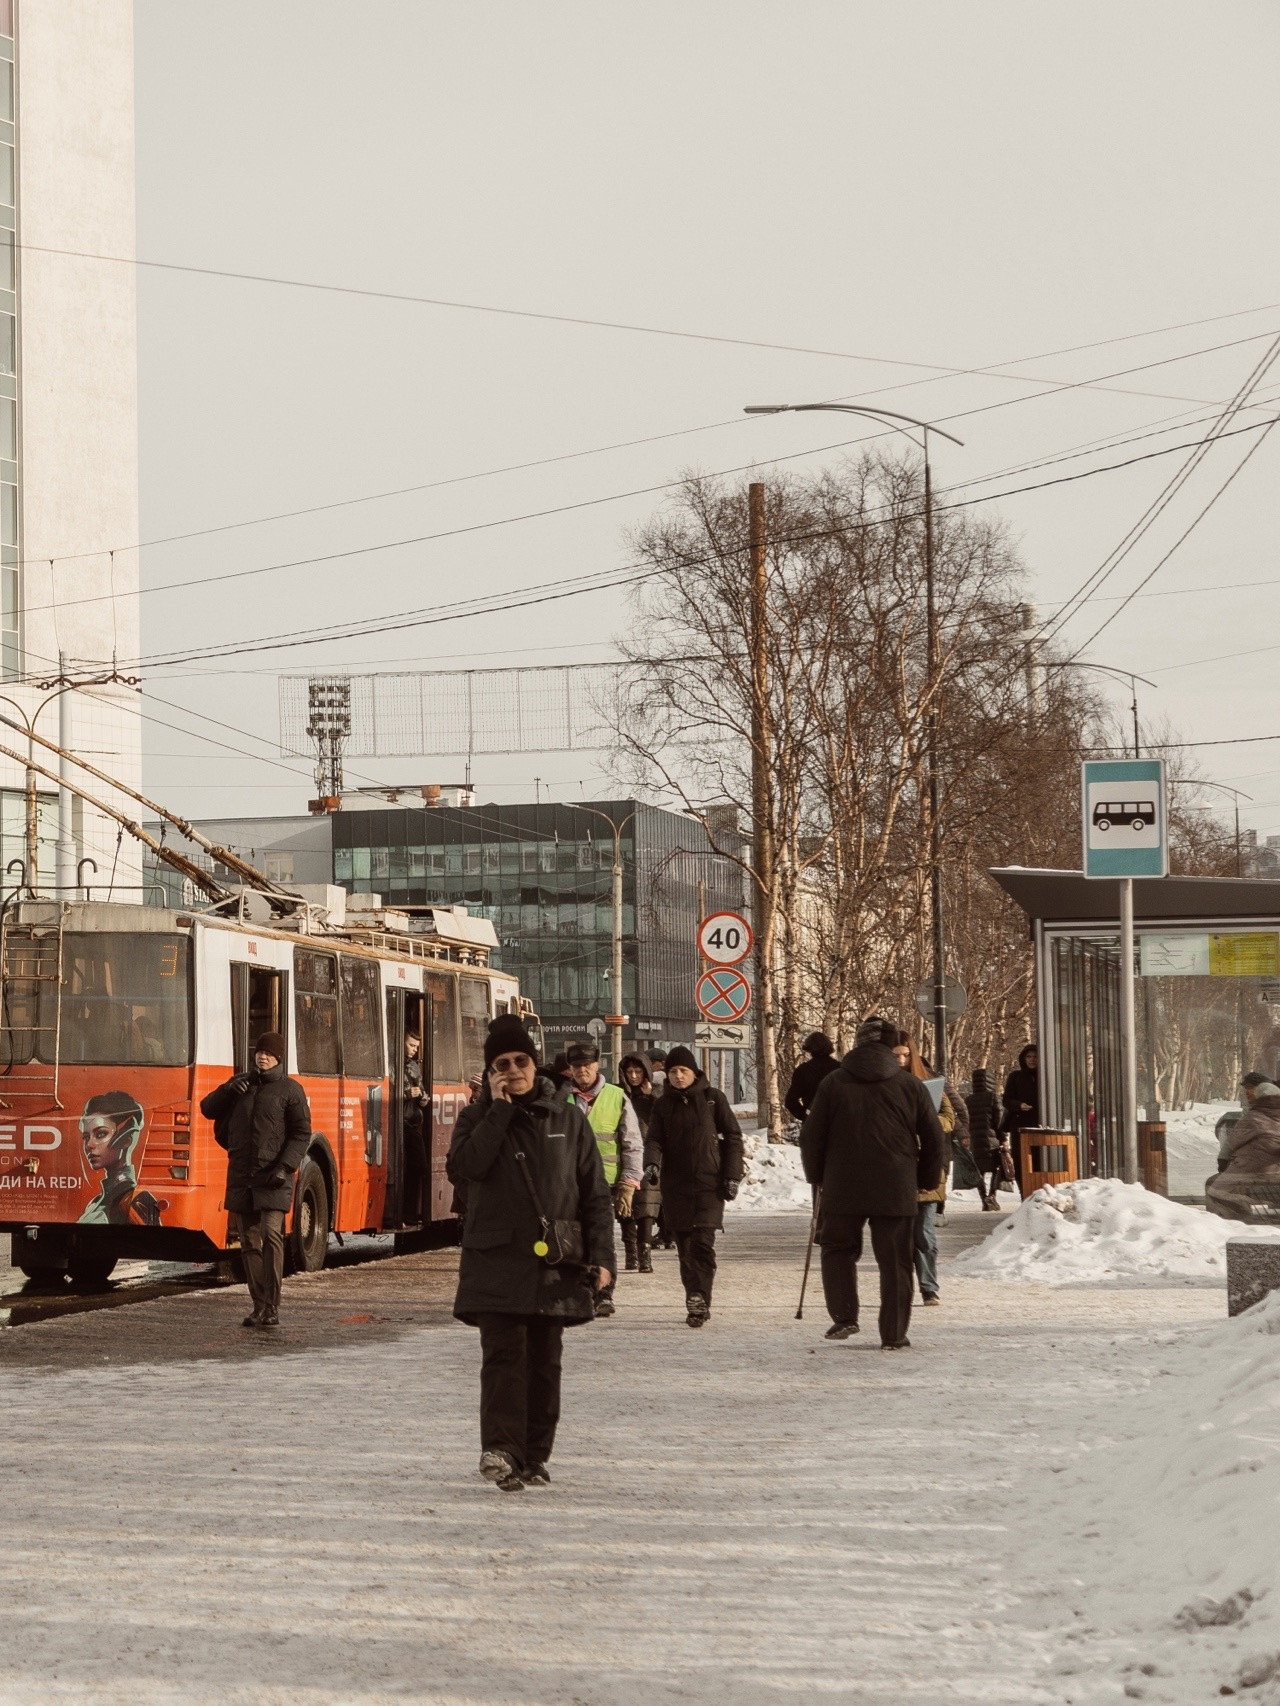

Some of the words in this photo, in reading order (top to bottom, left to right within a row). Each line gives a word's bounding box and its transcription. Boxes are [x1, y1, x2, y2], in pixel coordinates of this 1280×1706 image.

[707, 928, 740, 949] 40
[160, 945, 178, 976] 3
[561, 1025, 586, 1033] РОССИИ
[26, 1176, 46, 1188] НА
[50, 1176, 82, 1189] RED!
